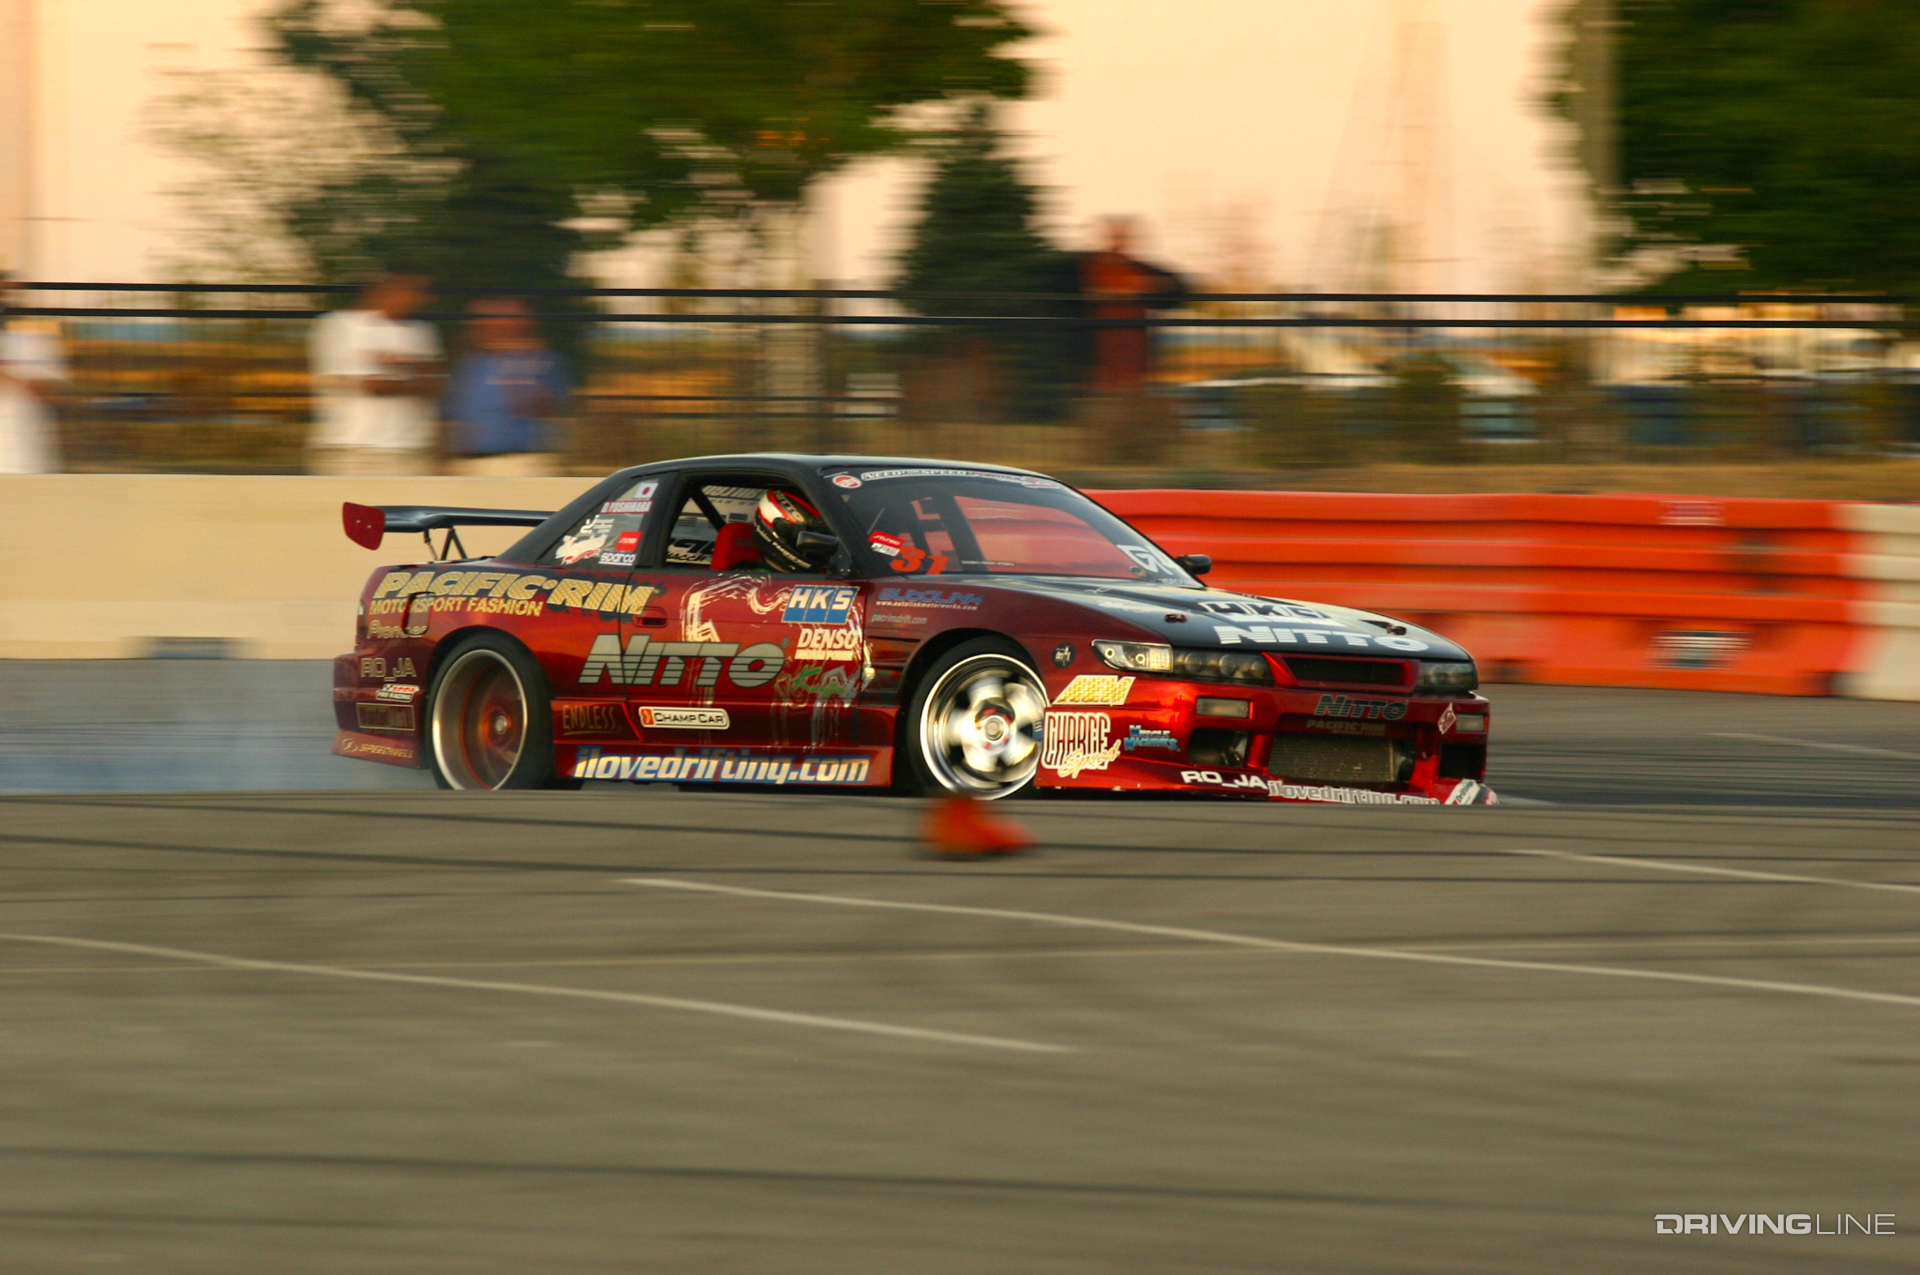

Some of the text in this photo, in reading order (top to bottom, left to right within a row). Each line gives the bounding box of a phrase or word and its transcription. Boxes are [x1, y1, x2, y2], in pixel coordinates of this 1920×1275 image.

[600, 553, 636, 564] sparco
[890, 546, 950, 575] 31
[467, 597, 544, 616] FASHION
[788, 588, 857, 611] HKS
[797, 628, 859, 649] DENSO
[1213, 625, 1429, 651] NITTO
[578, 634, 786, 688] NITTO
[562, 704, 618, 730] ENDLESS
[653, 711, 725, 725] CHAMP CAR
[1315, 694, 1409, 721] NITTO
[574, 746, 870, 784] ilovedrifting.com
[1181, 770, 1268, 790] RO_JA
